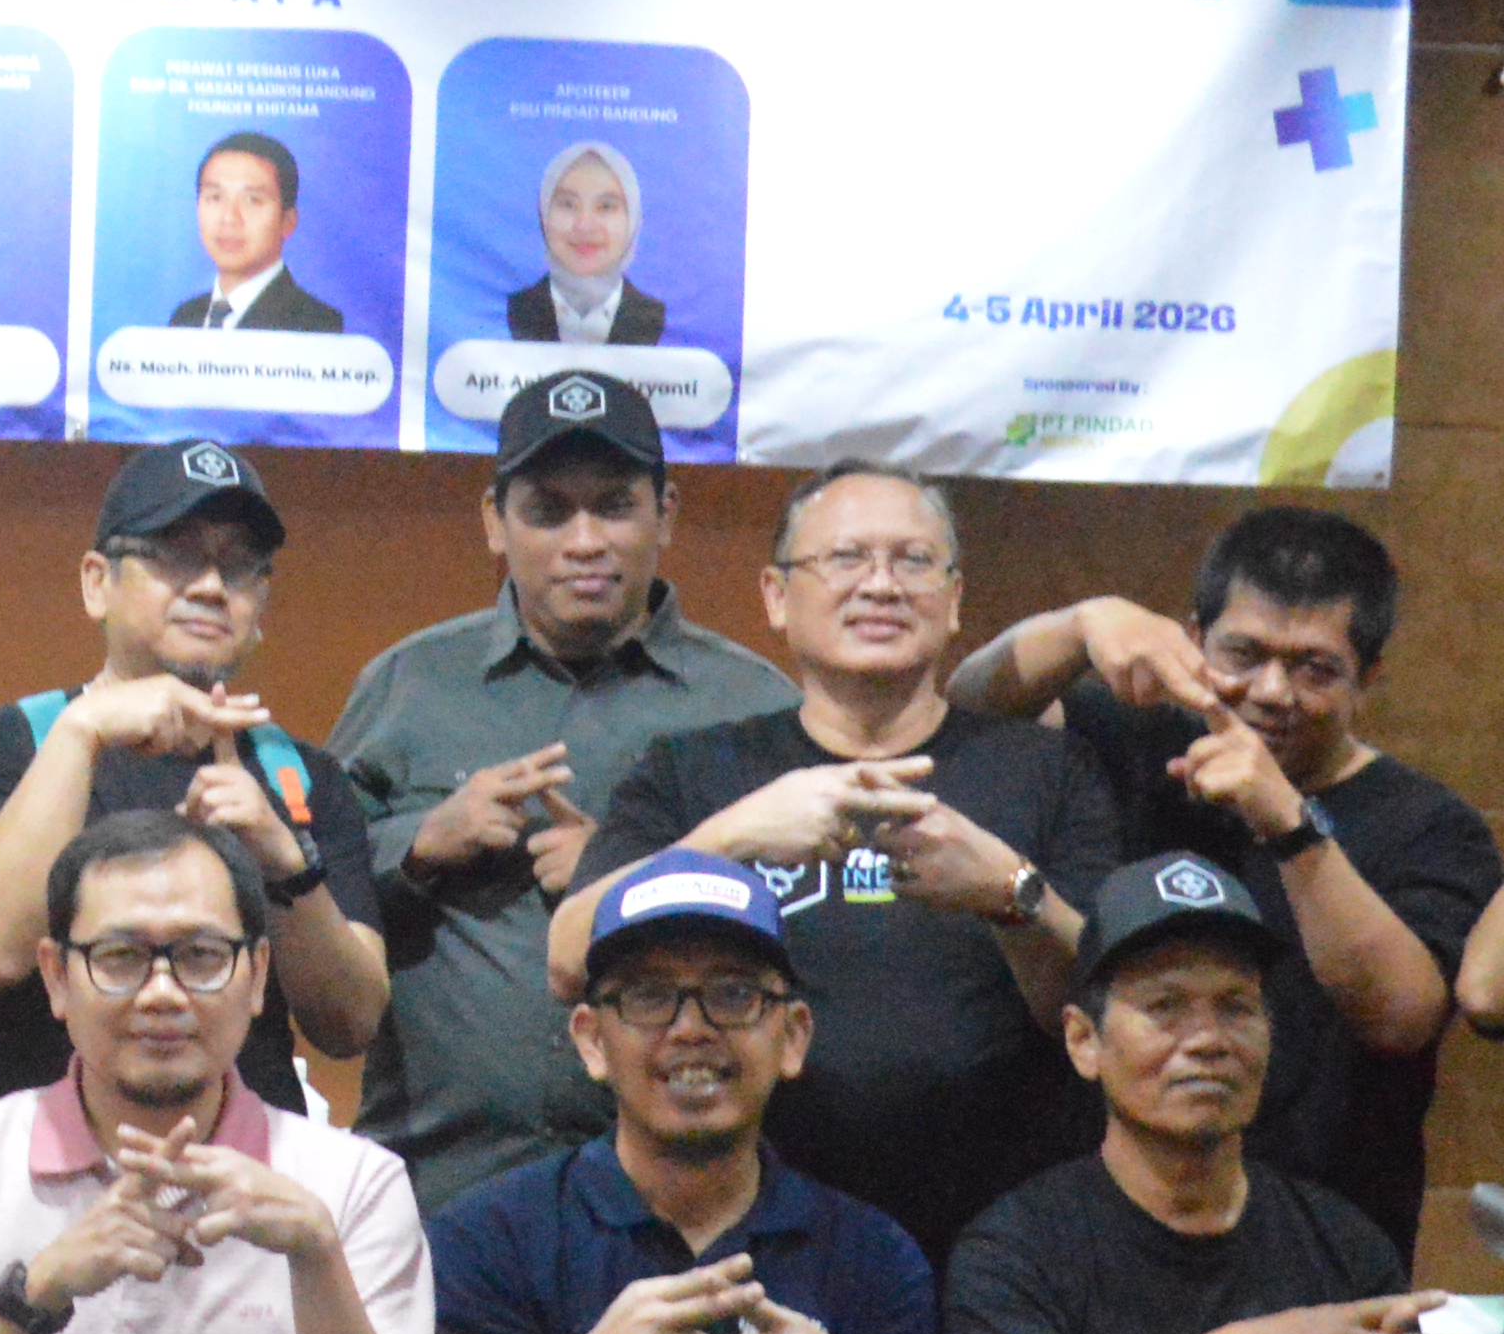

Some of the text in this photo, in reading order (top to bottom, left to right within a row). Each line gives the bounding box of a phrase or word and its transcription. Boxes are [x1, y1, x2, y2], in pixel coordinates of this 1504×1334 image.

[1020, 296, 1124, 331] April
[1132, 300, 1237, 333] 2026
[465, 373, 505, 393] Apt.
[1043, 414, 1154, 434] PT PINDAD
